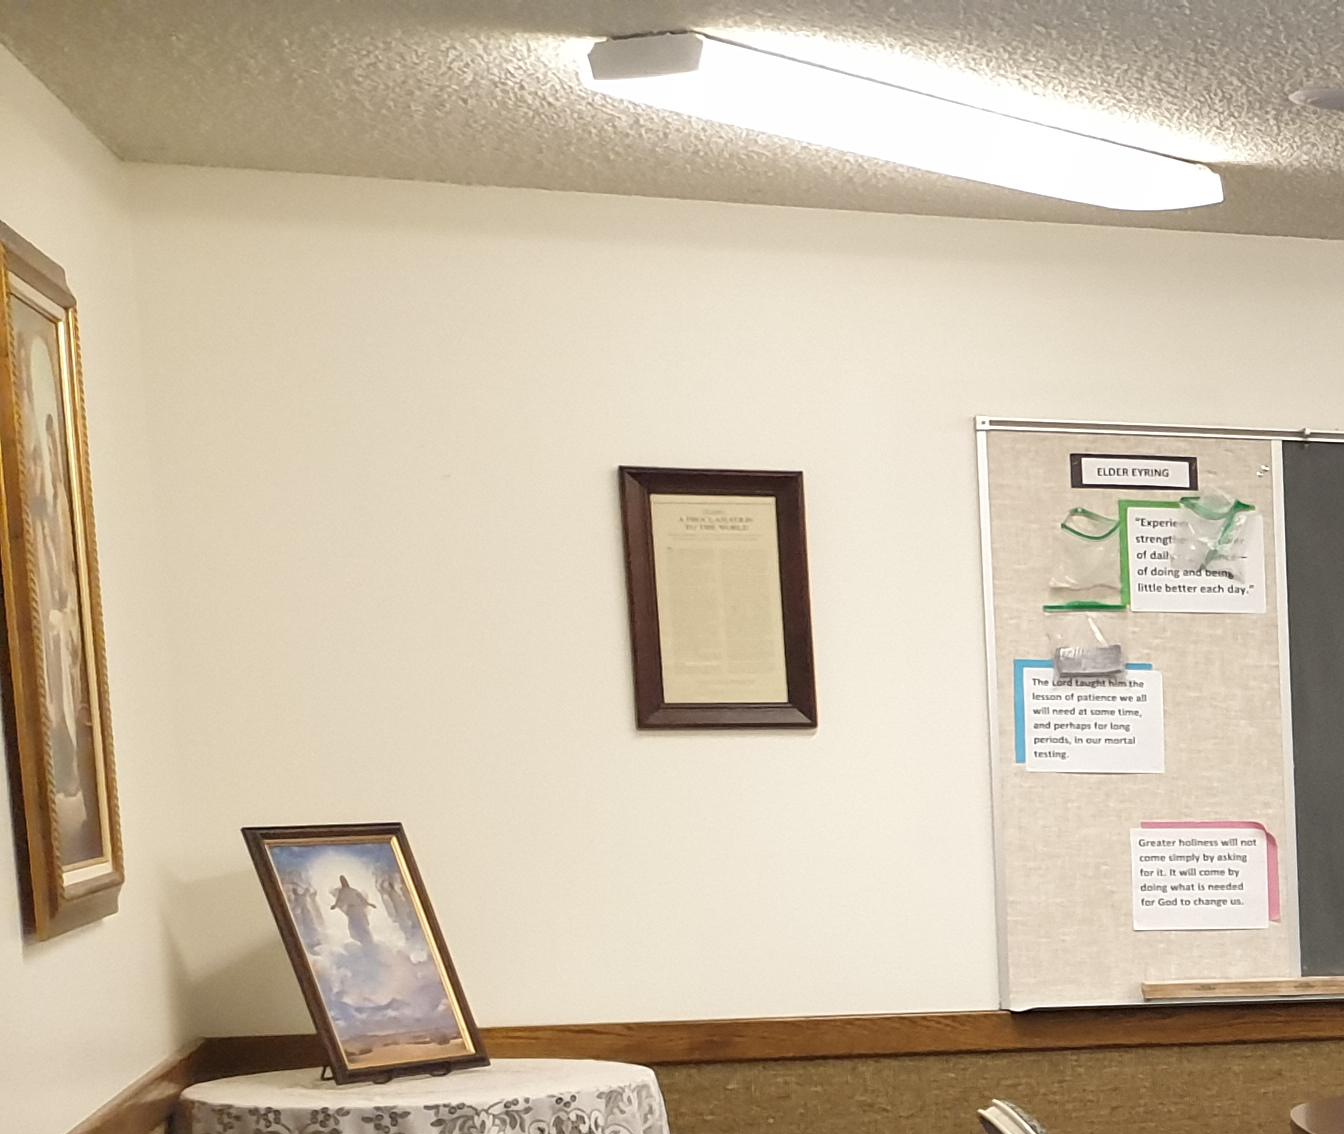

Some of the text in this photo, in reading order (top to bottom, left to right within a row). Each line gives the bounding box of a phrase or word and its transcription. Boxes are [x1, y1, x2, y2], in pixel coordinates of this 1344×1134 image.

[1097, 467, 1169, 478] ELDER EYRING
[1137, 550, 1146, 559] of
[1137, 566, 1148, 576] of
[1151, 567, 1180, 578] doing
[1138, 583, 1162, 592] little
[1165, 584, 1197, 593] better
[1200, 585, 1224, 593] each
[1032, 678, 1049, 687] The
[1129, 680, 1144, 688] the
[1032, 692, 1062, 701] lesson
[1065, 693, 1074, 701] of
[1077, 693, 1117, 704] patience
[1136, 694, 1147, 702] all
[1033, 707, 1050, 716] will
[1052, 707, 1075, 716] need
[1078, 708, 1087, 716] at
[1034, 722, 1130, 732] and perhaps for long
[1086, 737, 1101, 745] our
[1104, 736, 1136, 745] mortal
[1139, 838, 1256, 847] Greater holiness will not
[1139, 853, 1247, 863] come simply by asking
[1140, 869, 1154, 877] for
[1169, 869, 1176, 877] It
[1179, 868, 1196, 876] will
[1228, 868, 1239, 878] by
[1140, 883, 1244, 893] doing what is needed
[1141, 898, 1155, 907] for
[1158, 898, 1177, 906] God
[1193, 898, 1228, 907] change
